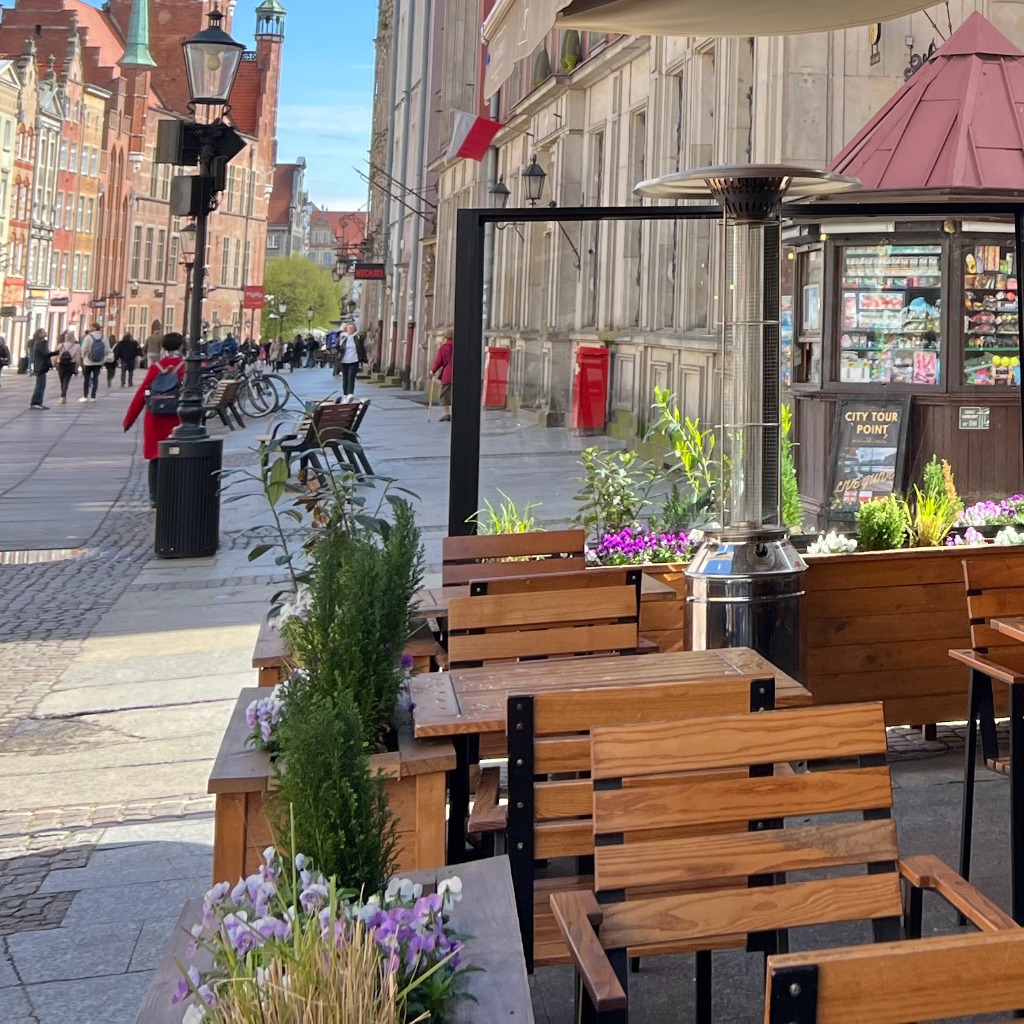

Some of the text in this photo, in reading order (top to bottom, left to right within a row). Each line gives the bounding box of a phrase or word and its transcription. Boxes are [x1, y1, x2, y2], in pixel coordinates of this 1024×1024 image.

[844, 411, 898, 422] CITY TOUR
[856, 424, 889, 435] POINT
